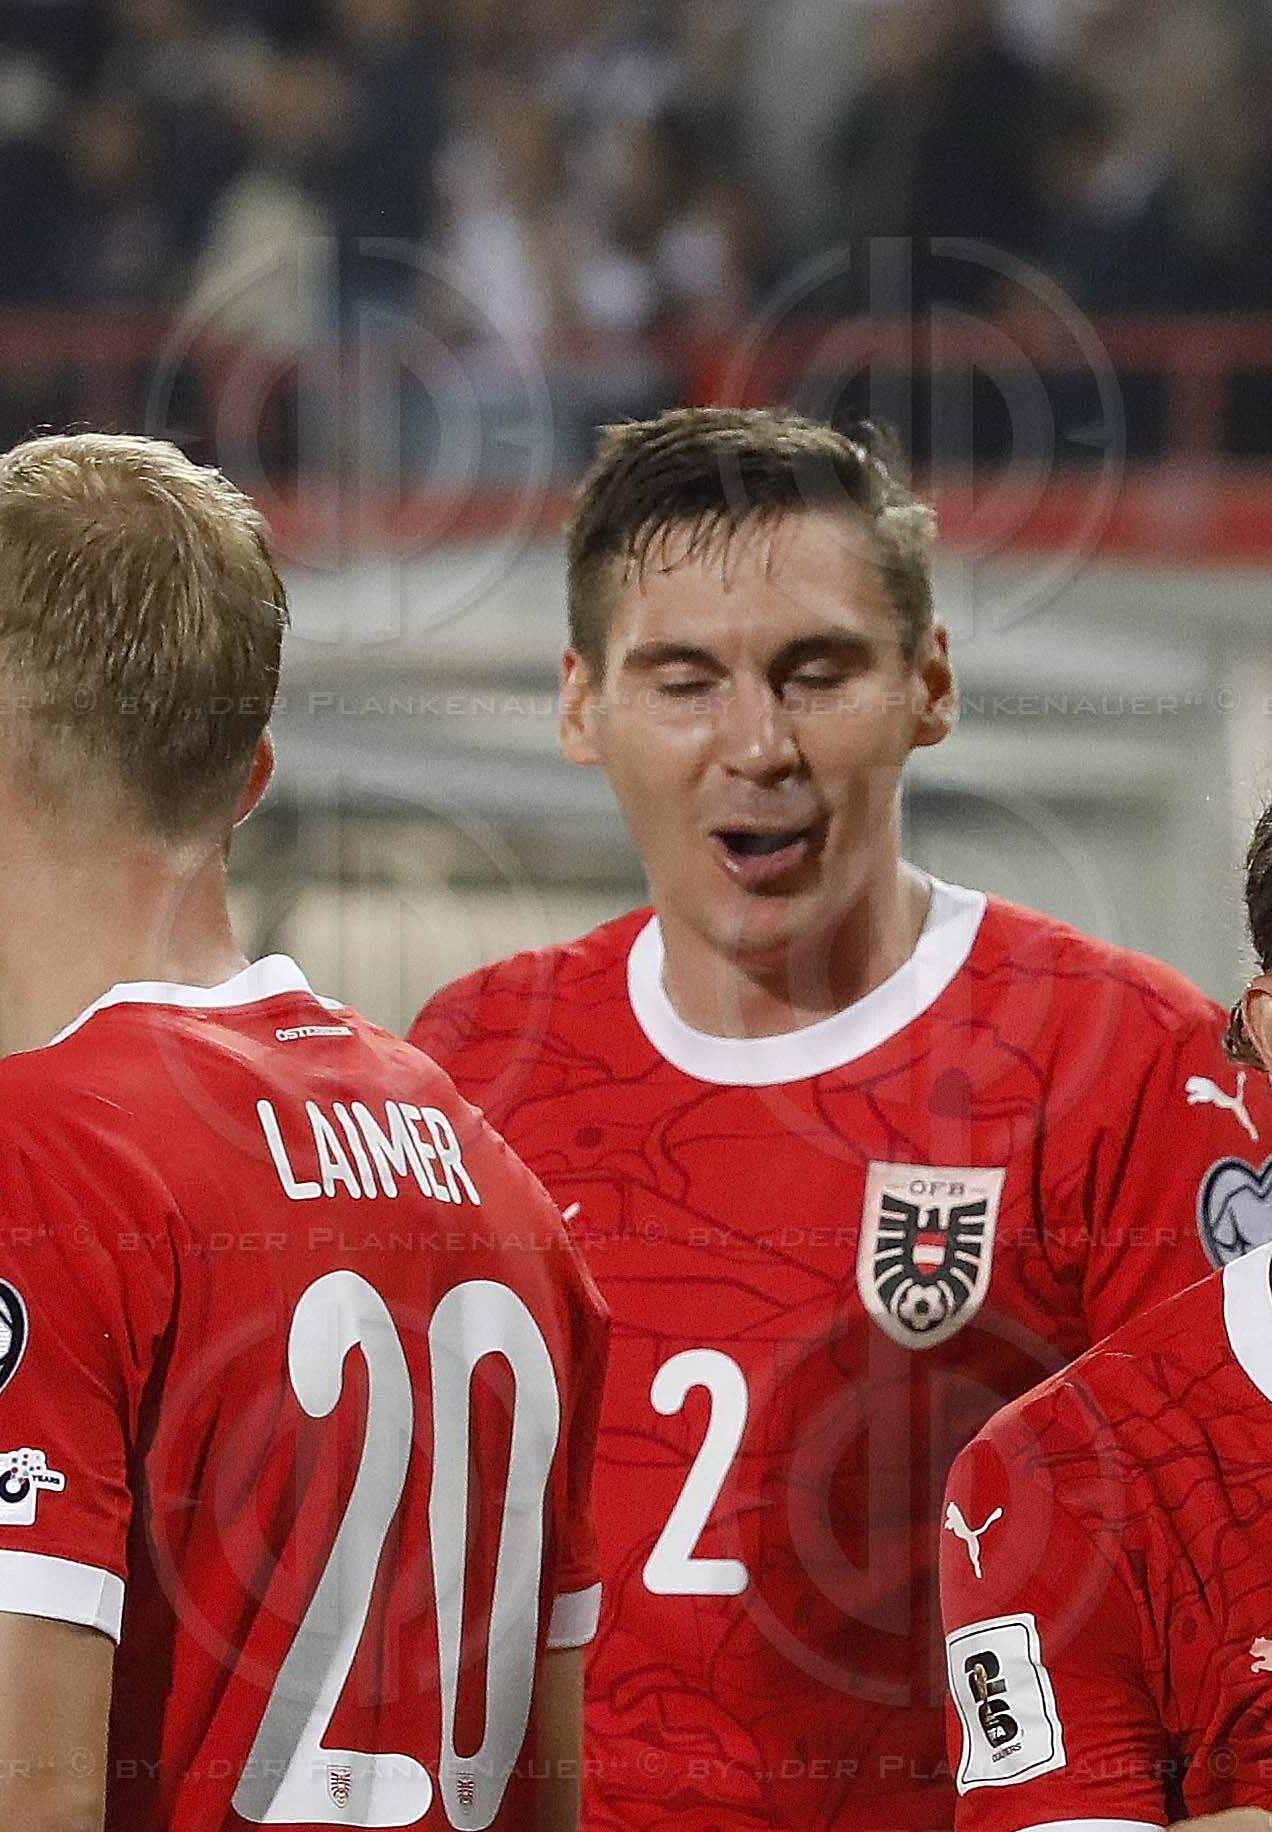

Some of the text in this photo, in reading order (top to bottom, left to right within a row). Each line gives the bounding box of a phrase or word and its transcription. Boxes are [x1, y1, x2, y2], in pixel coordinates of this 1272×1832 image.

[256, 1099, 481, 1206] LAIMER
[232, 1270, 561, 1831] 20
[642, 1348, 750, 1596] 2
